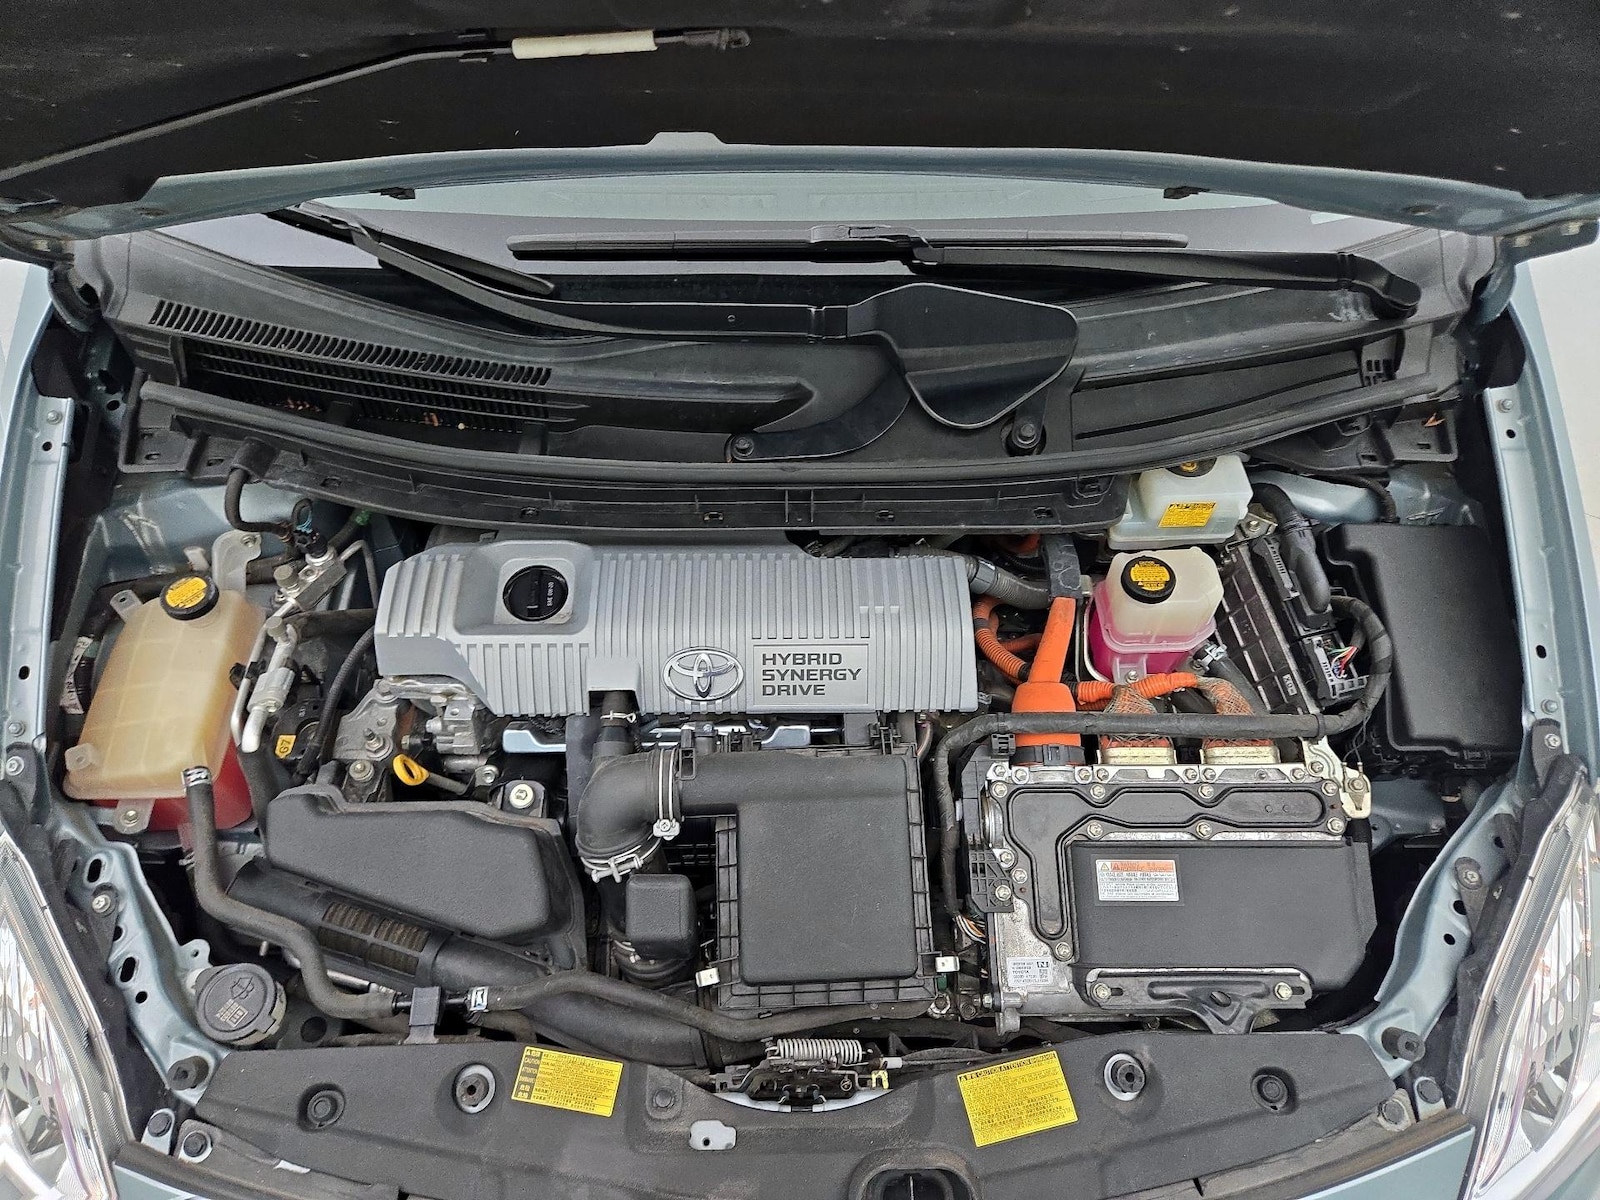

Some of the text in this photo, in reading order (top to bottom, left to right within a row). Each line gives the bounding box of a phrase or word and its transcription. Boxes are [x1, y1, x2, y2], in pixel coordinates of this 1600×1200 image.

[762, 653, 842, 665] HYBRID
[762, 668, 862, 681] SYNERGY
[762, 684, 826, 696] DRIVE
